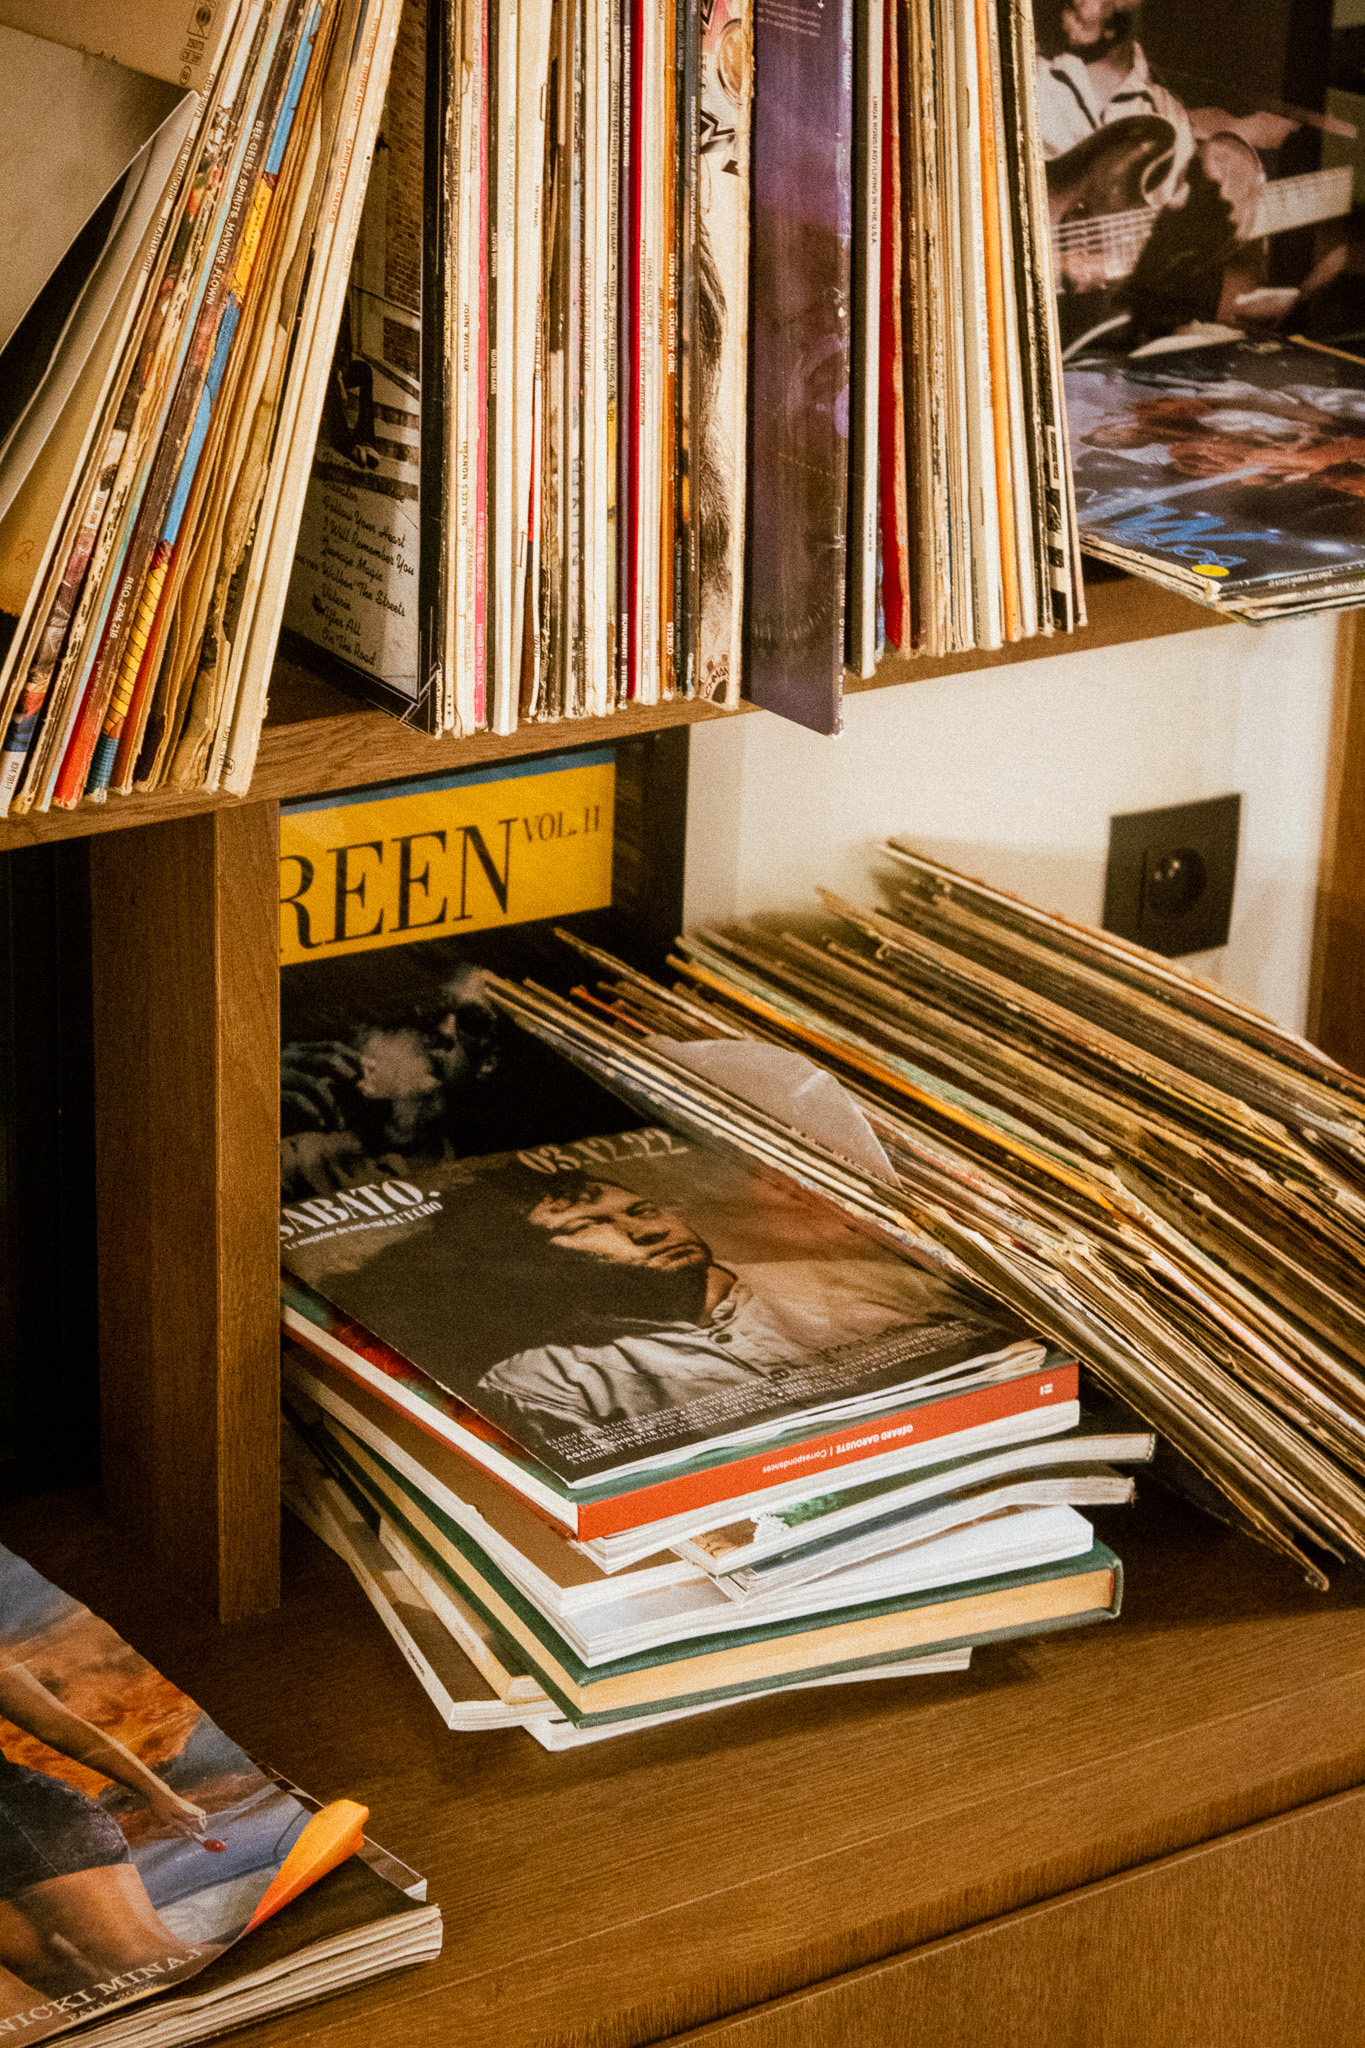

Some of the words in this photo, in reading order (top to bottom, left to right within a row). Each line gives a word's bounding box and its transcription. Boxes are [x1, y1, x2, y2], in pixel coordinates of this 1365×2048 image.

[251, 119, 264, 139] BEE
[180, 136, 193, 156] NEIL
[242, 141, 258, 169] GEES
[165, 157, 186, 201] DIAMOND
[228, 177, 248, 218] SPIRITS
[140, 215, 166, 272] HEARTLIGHT
[215, 221, 235, 264] HAVING
[203, 267, 222, 305] FLOWN
[667, 275, 675, 300] KAYE
[462, 302, 470, 327] JOHN
[667, 307, 675, 351] COUNTRY
[462, 332, 470, 372] WILLIAM
[667, 352, 675, 375] GIRL
[396, 553, 415, 576] You
[120, 575, 135, 598] RSO
[113, 600, 127, 623] 2394
[375, 592, 406, 618] Streets
[108, 621, 121, 639] 216
[345, 618, 362, 637] All
[620, 612, 628, 659] MONUMENT
[666, 621, 674, 655] STEREO
[619, 664, 627, 696] STEREO
[519, 808, 578, 844] VOL.
[583, 806, 601, 832] II
[296, 1224, 335, 1250] magazine
[563, 1442, 611, 1460] AGATHA
[607, 1428, 658, 1447] CHRISTIE
[836, 1433, 880, 1454] GAROUSTE
[880, 1424, 914, 1440] GÉRARD
[762, 1449, 827, 1474] Correspondances
[0, 1986, 96, 2037] NICKI
[92, 1947, 203, 1997] MINAJ
